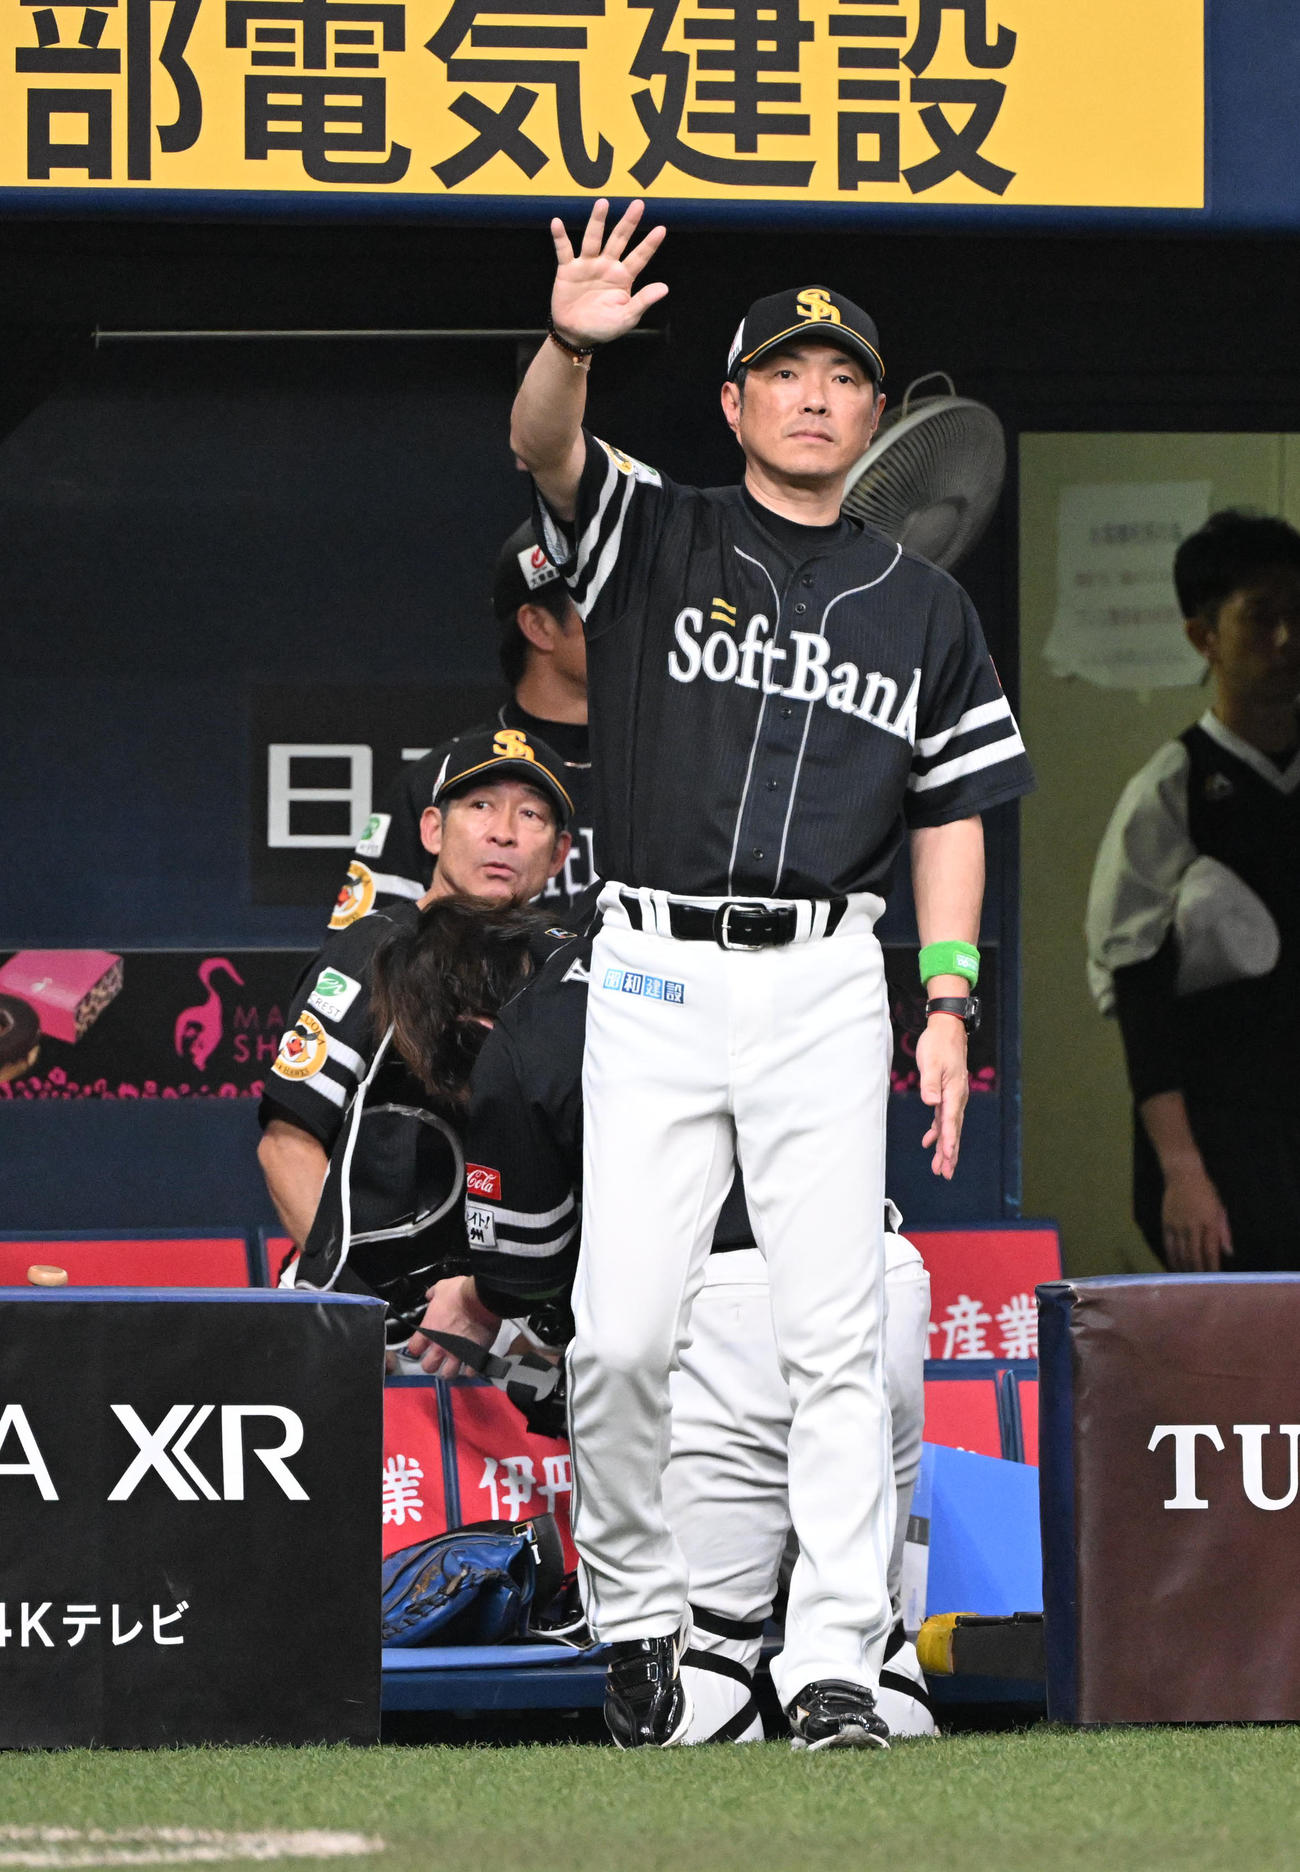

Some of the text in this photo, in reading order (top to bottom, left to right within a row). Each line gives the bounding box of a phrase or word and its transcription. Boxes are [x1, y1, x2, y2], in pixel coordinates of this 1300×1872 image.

[15, 0, 1017, 196] 部電気建設
[268, 744, 432, 847] 日
[107, 1404, 310, 1500] XR
[1147, 1424, 1300, 1511] TU
